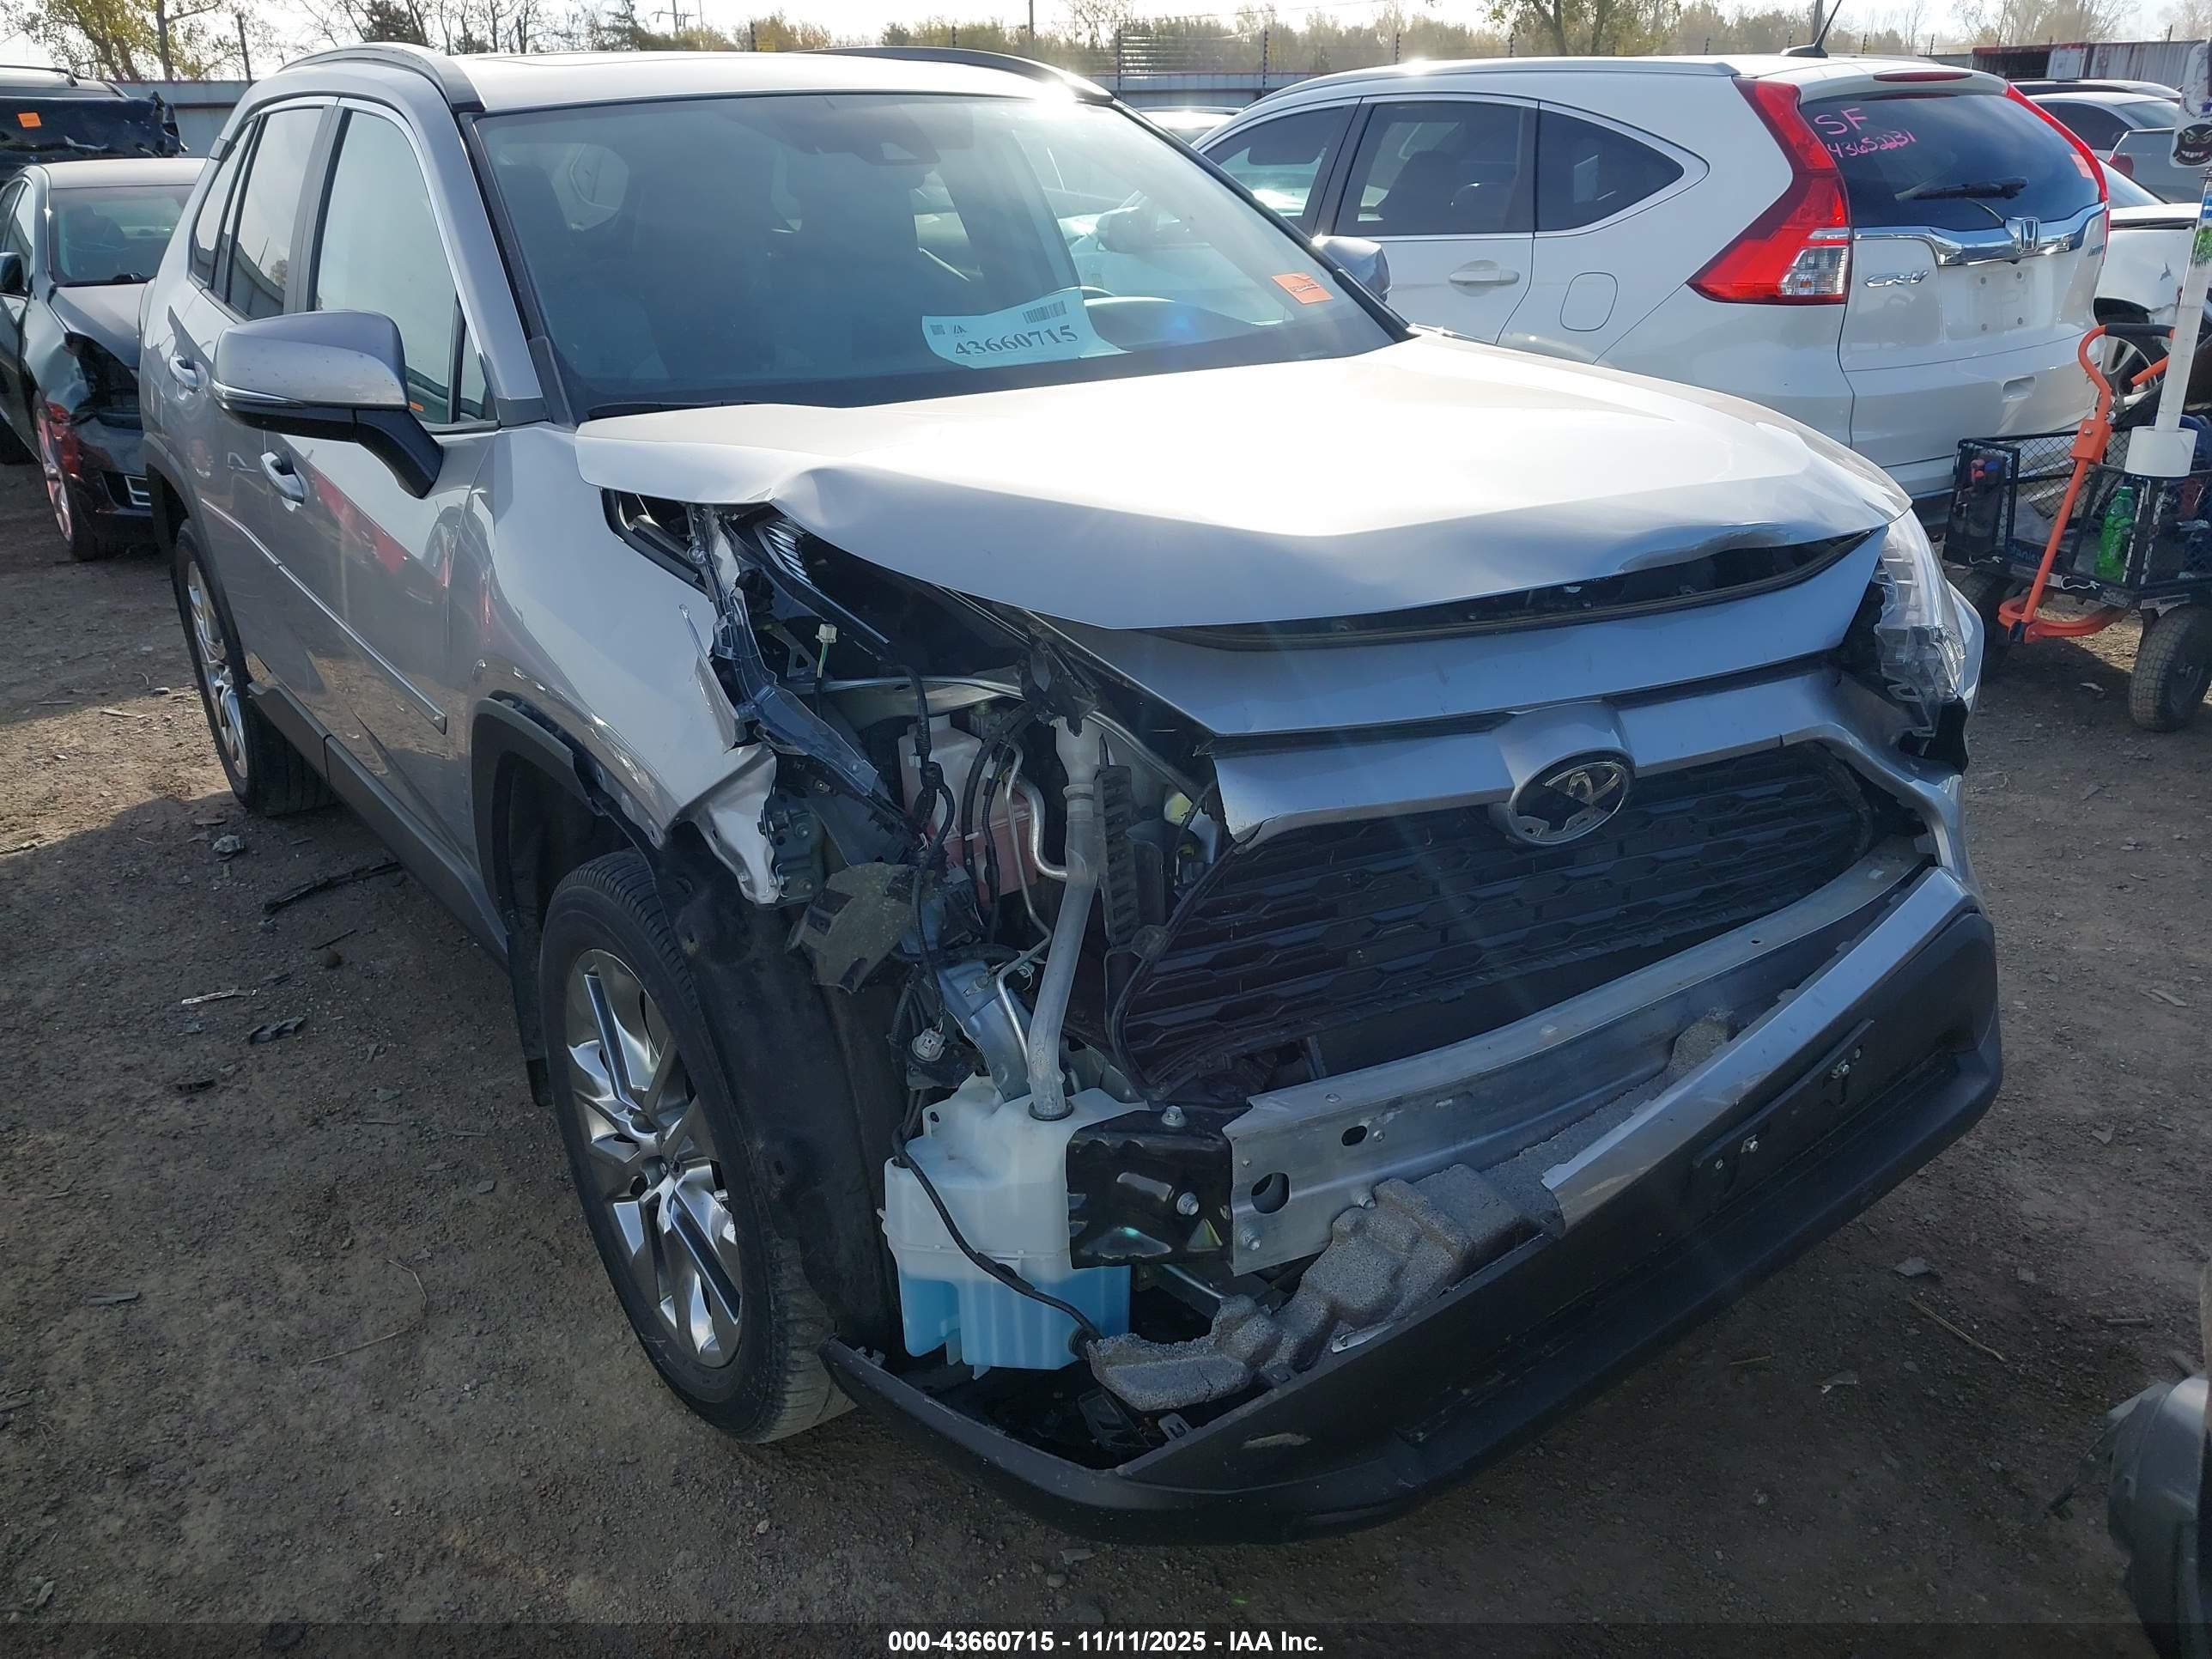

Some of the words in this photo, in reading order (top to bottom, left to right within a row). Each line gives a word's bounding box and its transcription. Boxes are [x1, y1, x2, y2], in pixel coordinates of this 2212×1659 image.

[1814, 107, 1869, 135] SF
[1864, 270, 1929, 288] CR-V
[955, 324, 1079, 356] 43660715
